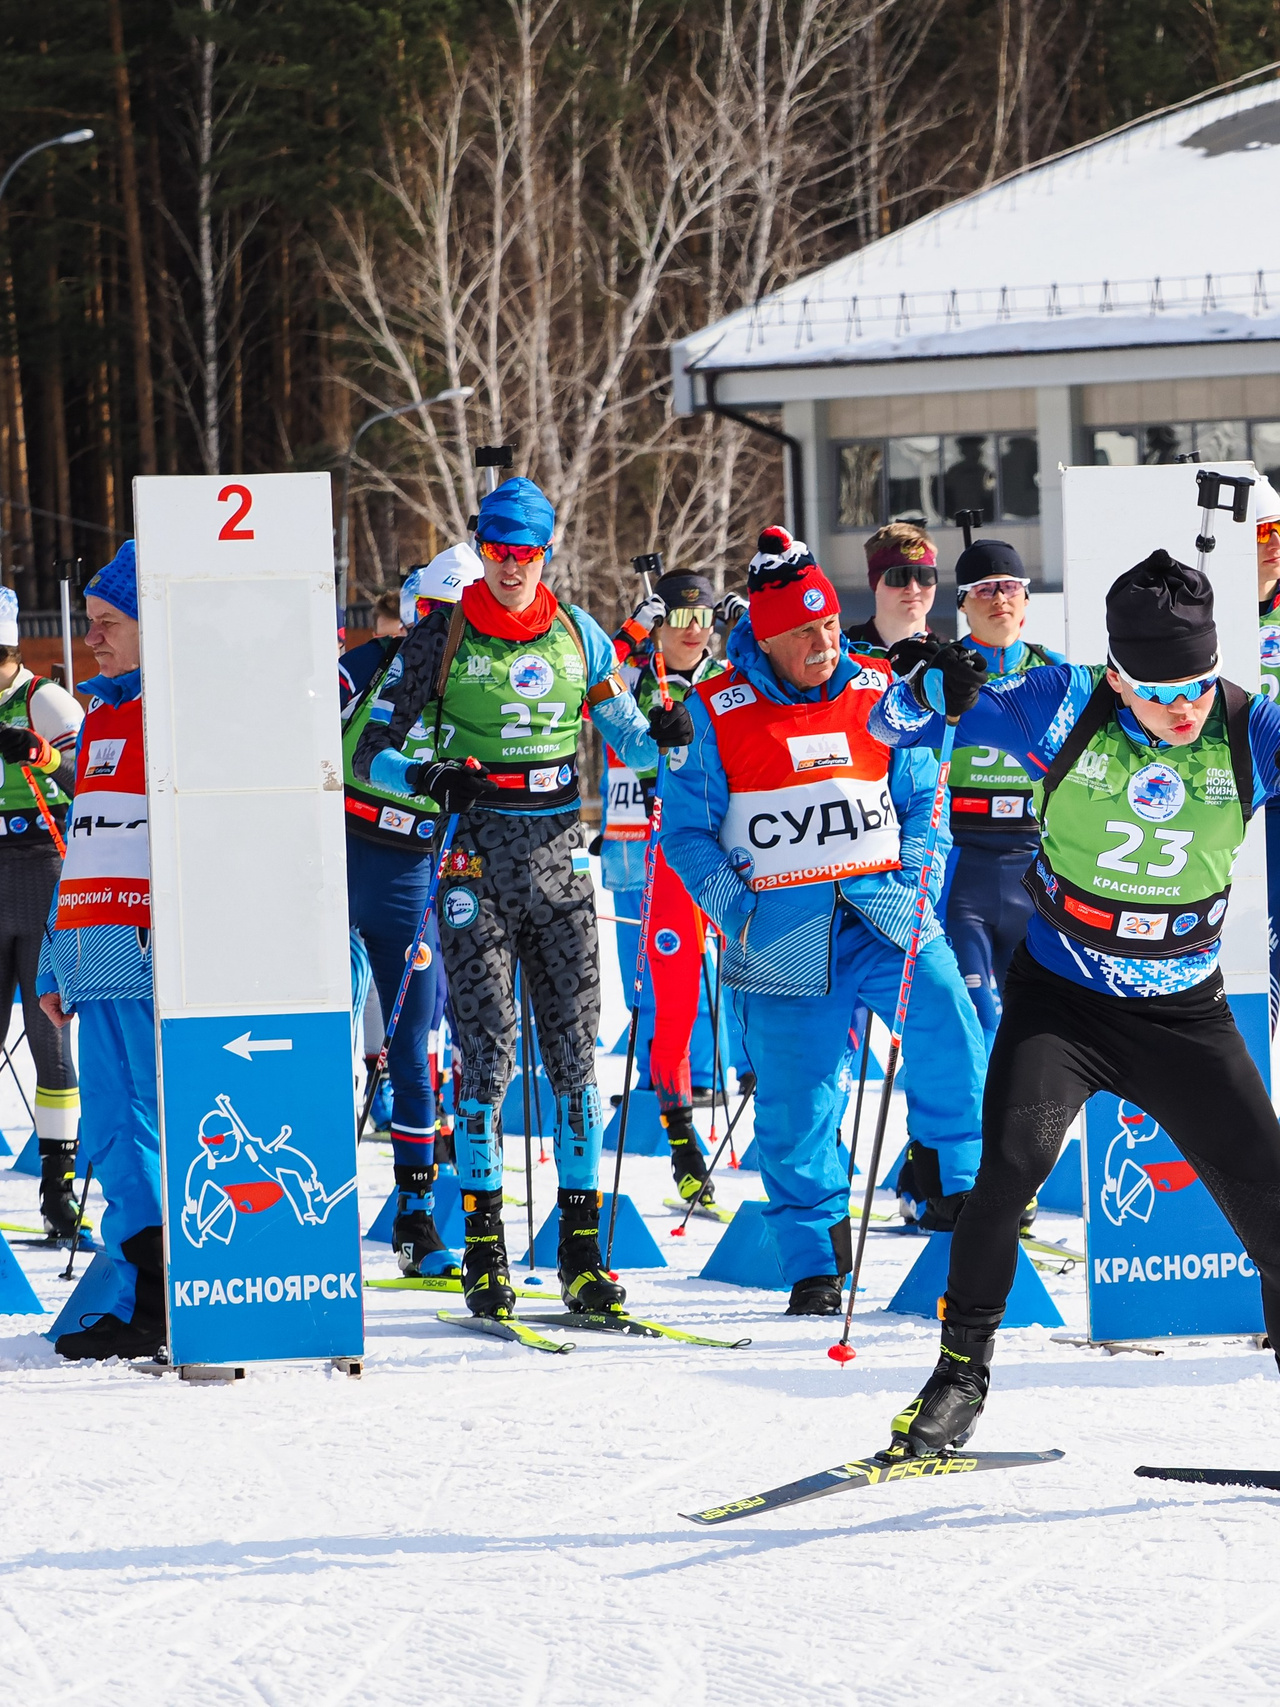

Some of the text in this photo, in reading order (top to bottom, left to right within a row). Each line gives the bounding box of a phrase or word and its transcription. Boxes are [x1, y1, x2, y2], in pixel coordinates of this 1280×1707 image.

[217, 484, 254, 541] 2
[859, 670, 881, 687] 35
[719, 687, 746, 709] 35
[501, 702, 566, 739] 27
[502, 743, 560, 756] КРАСНОЯРСК
[970, 773, 1029, 784] КРАСНОЯРСК
[1206, 777, 1234, 787] НОРМ
[749, 790, 895, 849] СУДЬЯ
[1096, 820, 1195, 878] 23
[1093, 875, 1182, 897] КРАСНОЯРСК
[58, 887, 150, 909] оярский кра
[411, 1172, 428, 1181] 181
[568, 1194, 586, 1205] 177
[1094, 1252, 1262, 1284] КРАСНОЯРС
[175, 1272, 358, 1307] КРАСНОЯРСК
[885, 1458, 978, 1482] FISCHER
[701, 1495, 766, 1521] FISCHER
